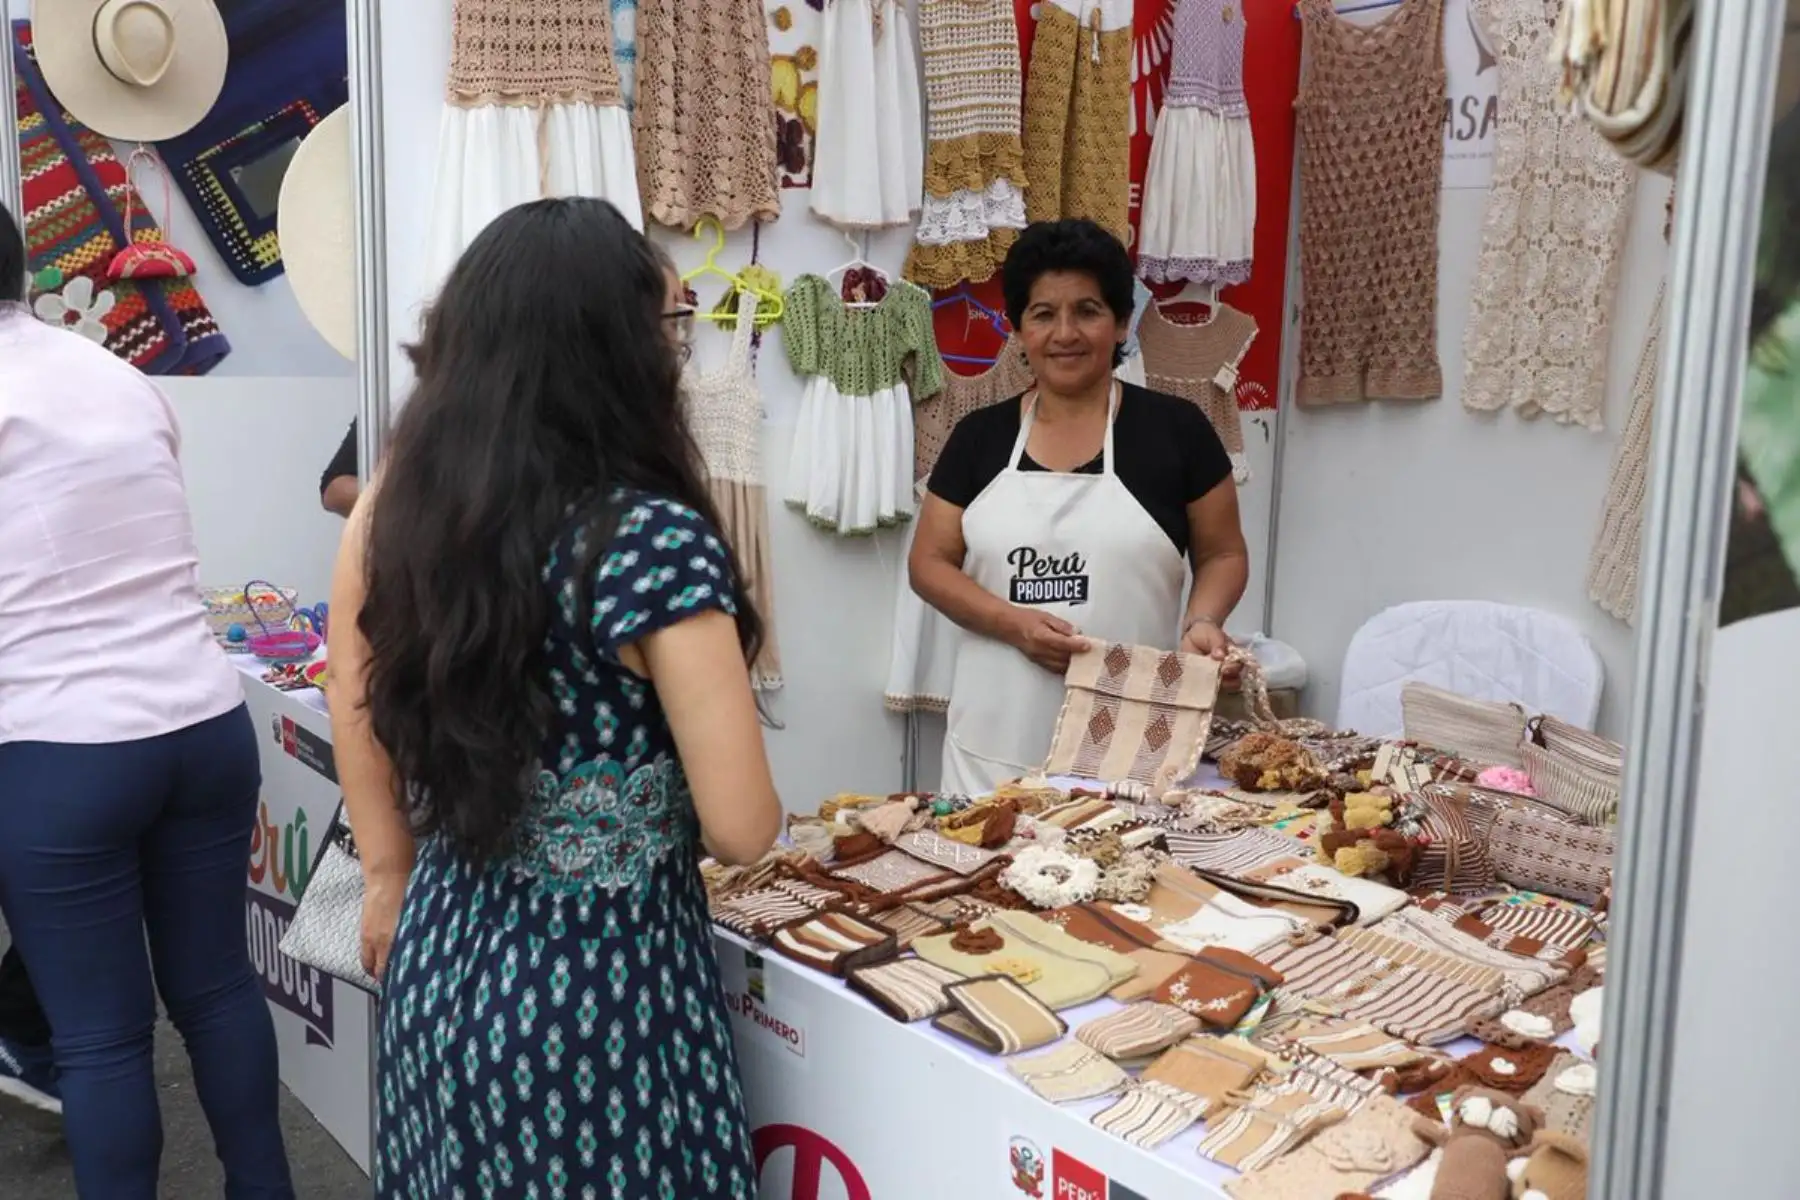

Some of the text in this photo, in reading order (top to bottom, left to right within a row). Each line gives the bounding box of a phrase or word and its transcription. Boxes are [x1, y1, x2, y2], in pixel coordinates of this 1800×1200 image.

[1007, 546, 1086, 578] Perú
[1016, 579, 1082, 601] PRODUCE
[249, 800, 309, 901] erú
[246, 899, 323, 1018] ODUCE
[742, 992, 799, 1045] PRIMERO
